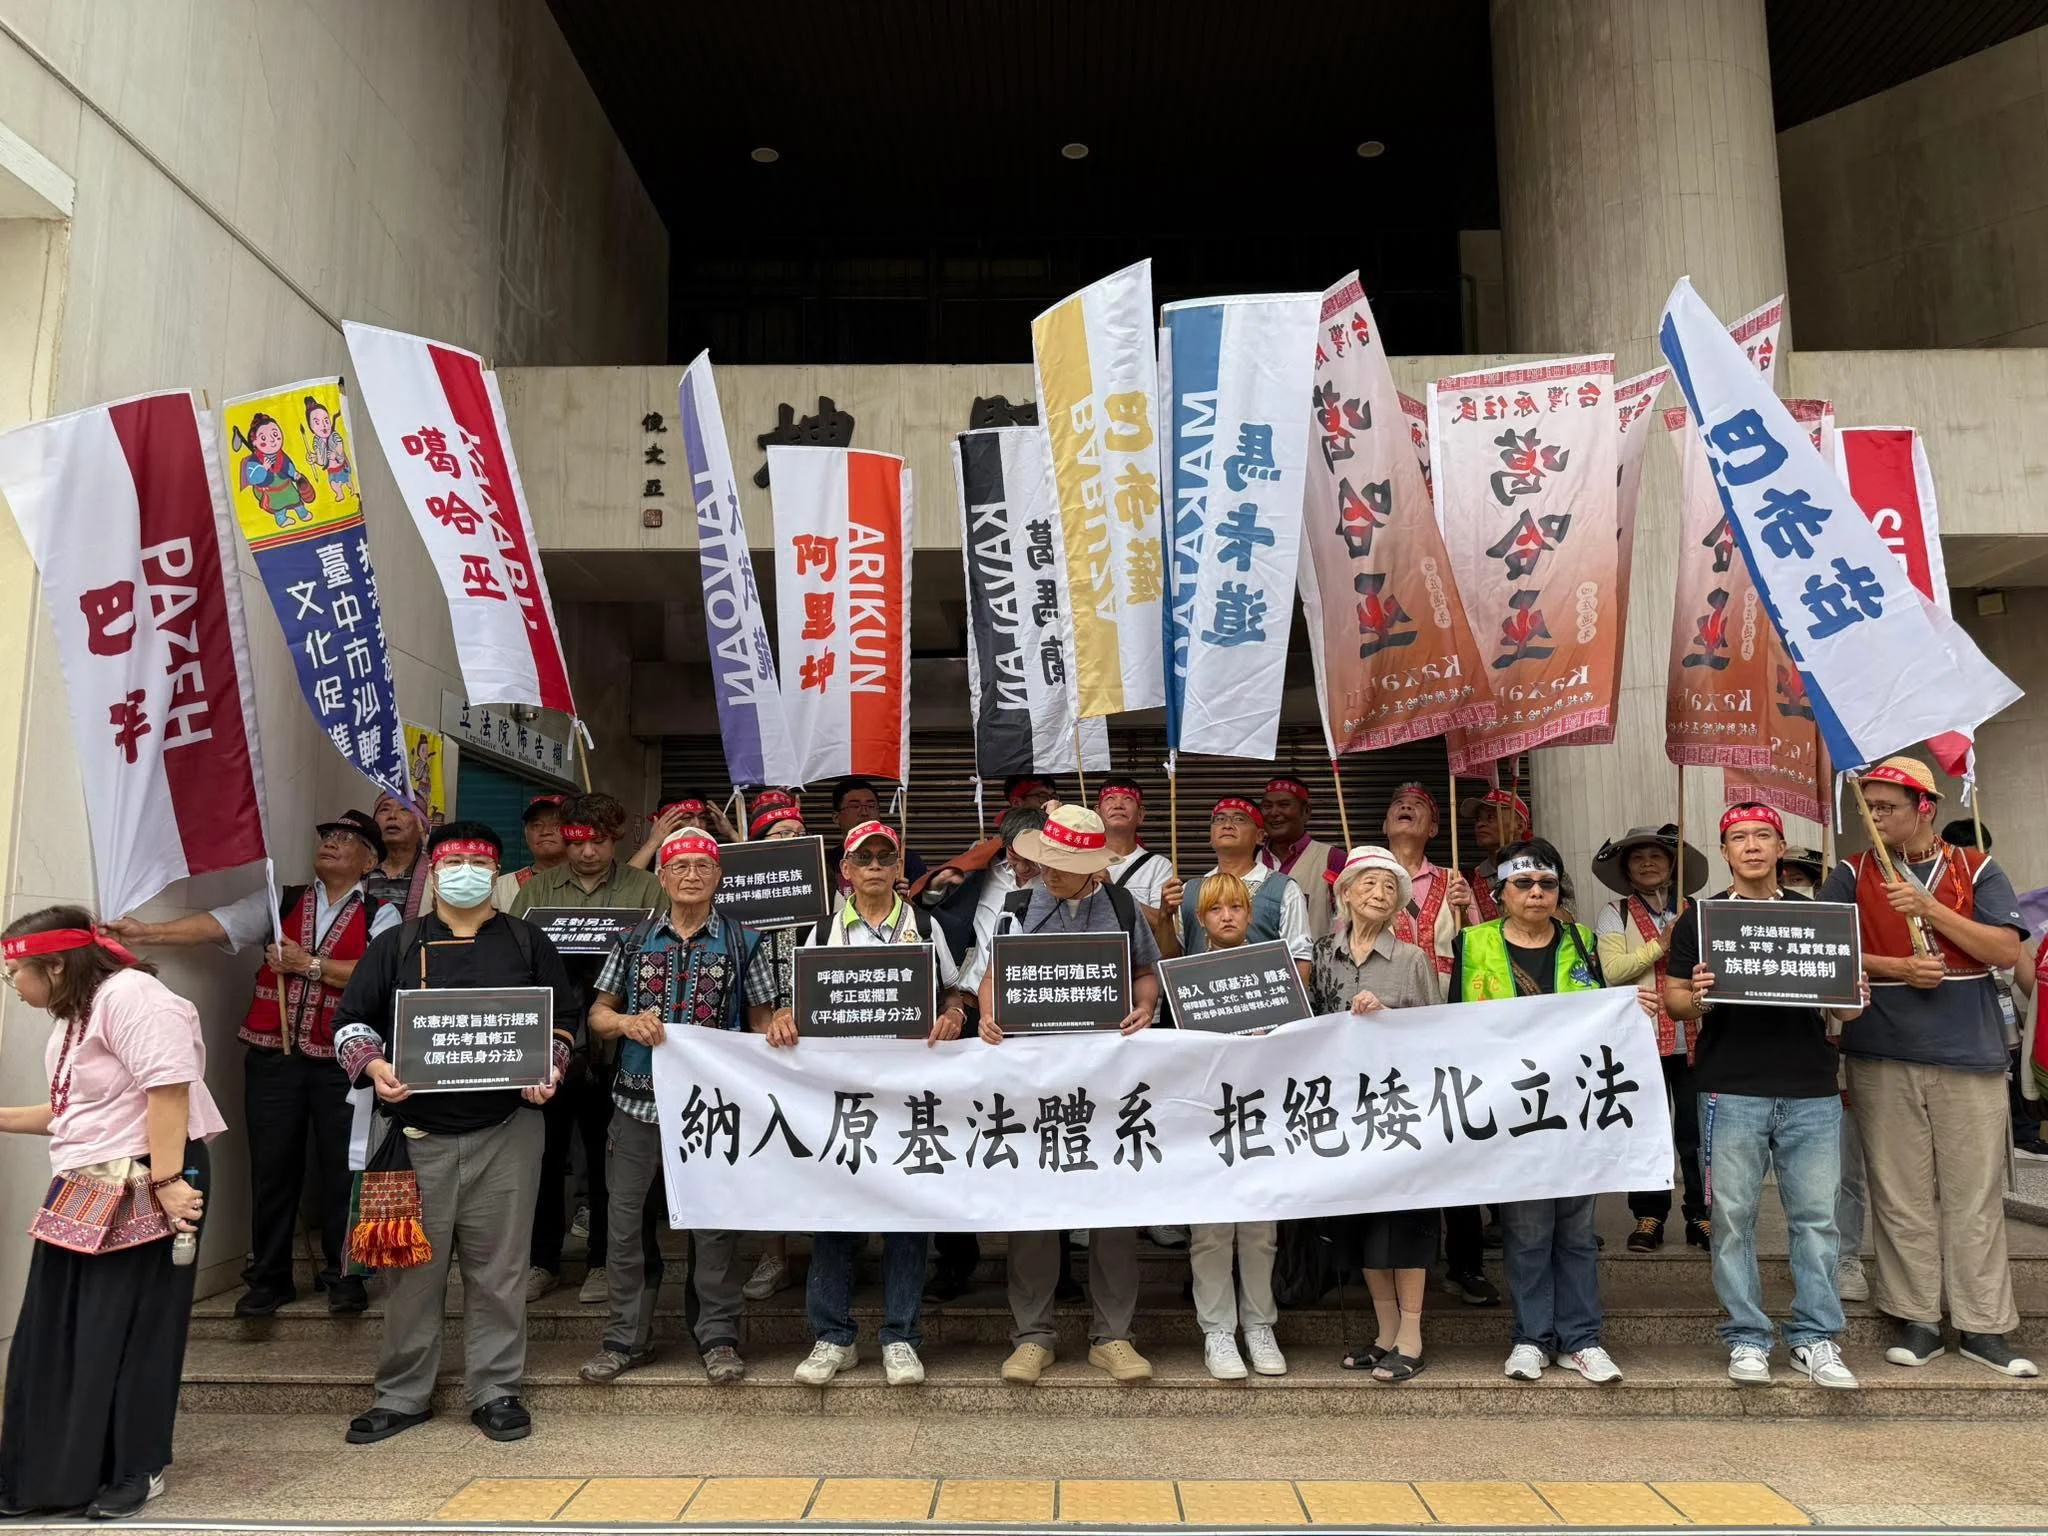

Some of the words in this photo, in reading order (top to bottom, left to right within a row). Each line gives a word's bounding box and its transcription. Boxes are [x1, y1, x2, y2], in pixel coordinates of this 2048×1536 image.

[641, 411, 668, 498] 倪文亞
[400, 425, 508, 602] 噶哈巫
[793, 533, 840, 695] 阿里坤
[847, 520, 886, 695] ARIKUN
[140, 535, 213, 752] PAZEH
[79, 579, 153, 766] 巴宰
[459, 700, 563, 768] 立法院佈告欄
[722, 868, 803, 889] 只有#原住民族
[551, 917, 616, 927] 反對另立
[1740, 925, 1816, 939] 修法過程需有
[1712, 940, 1851, 957] 完整、平等、具實質意義
[816, 967, 914, 985] 呼籲內政委員會
[1005, 963, 1118, 982] 拒絕任何殖民式
[1724, 957, 1836, 978] 族群參與機制
[829, 988, 899, 1004] 修正或擱置
[1005, 985, 1118, 1004] 修法與族群矮化
[412, 1012, 539, 1029] 依憲判意旨進行提案
[810, 1006, 922, 1025] 《平埔族群身分法》
[431, 1031, 517, 1047] 優先考量修正
[423, 1049, 524, 1066] 《原住民身分法》
[678, 1081, 1164, 1176] 納入原基法體系
[1209, 1044, 1641, 1168] 拒絕矮化立法
